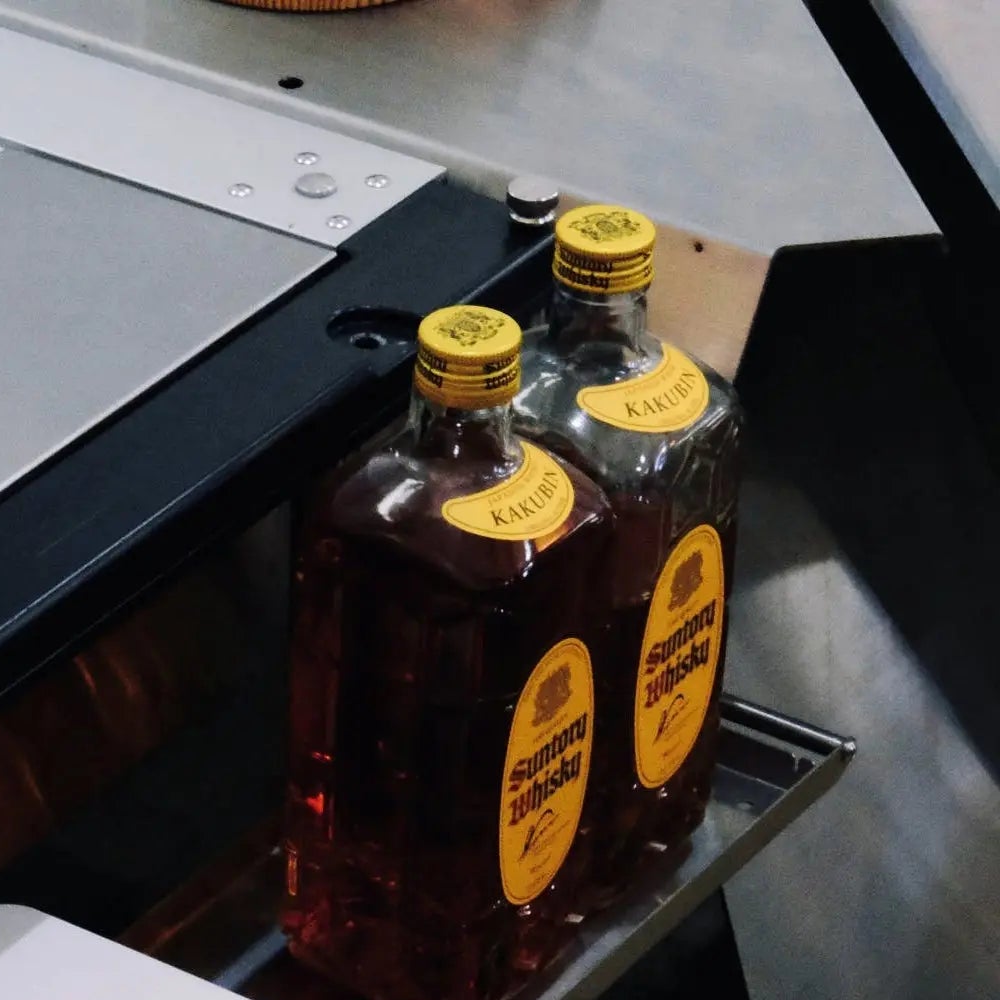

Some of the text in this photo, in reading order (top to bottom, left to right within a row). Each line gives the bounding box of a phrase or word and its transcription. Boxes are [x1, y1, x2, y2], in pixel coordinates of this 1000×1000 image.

[623, 371, 698, 418] KAKUBIN
[490, 470, 559, 527] KAKUBIN
[644, 598, 717, 675] Suntory
[644, 636, 711, 709] Whisky
[507, 711, 588, 793] Suntory
[507, 751, 582, 827] Whisky
